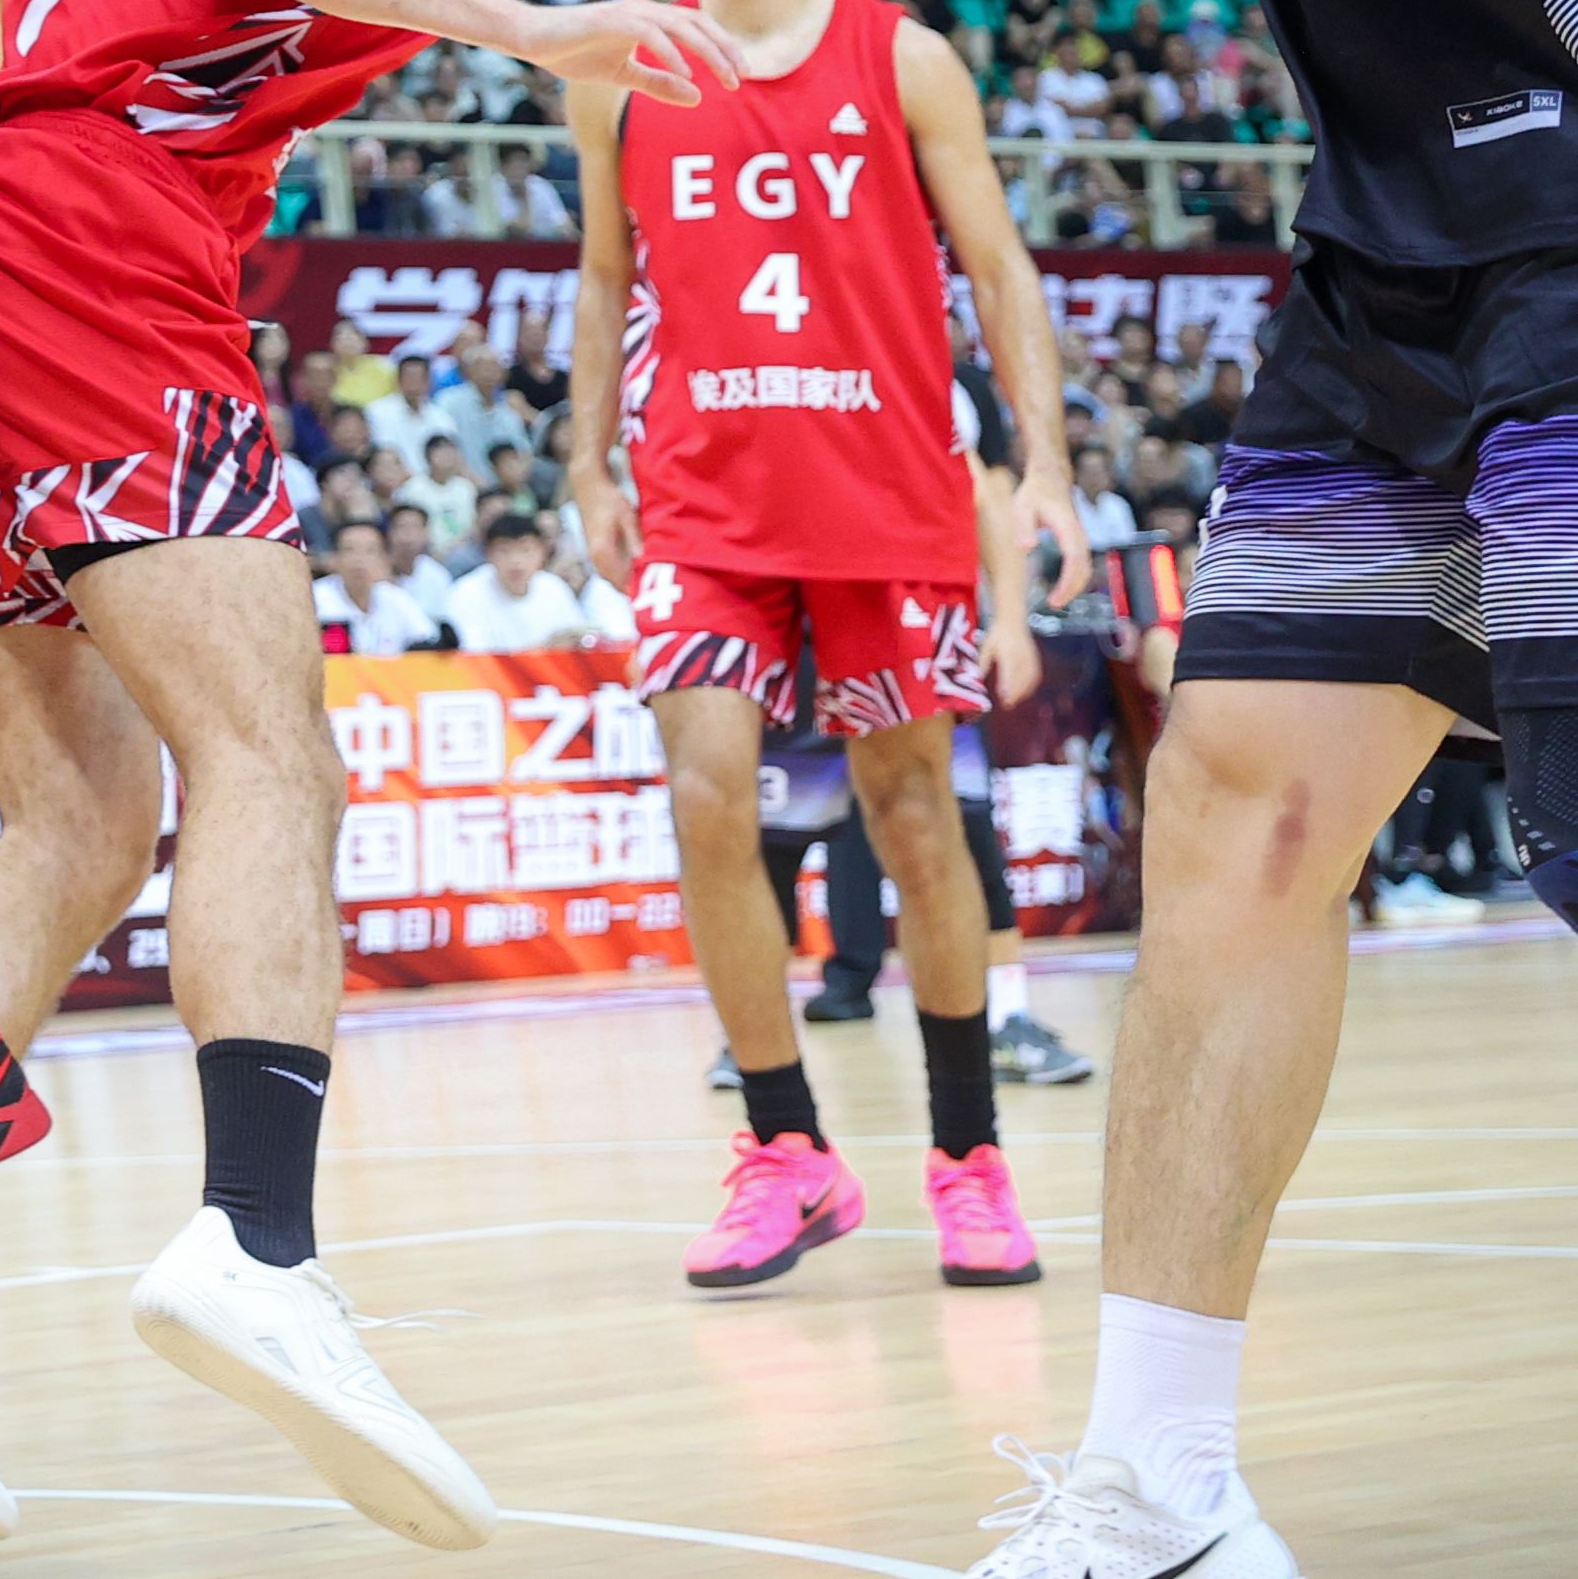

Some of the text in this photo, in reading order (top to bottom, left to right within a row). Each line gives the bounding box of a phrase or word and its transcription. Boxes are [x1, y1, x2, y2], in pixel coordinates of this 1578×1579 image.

[670, 151, 866, 222] EGY
[738, 252, 811, 334] 4
[687, 364, 882, 413] 埃及国家队
[631, 562, 684, 622] 4
